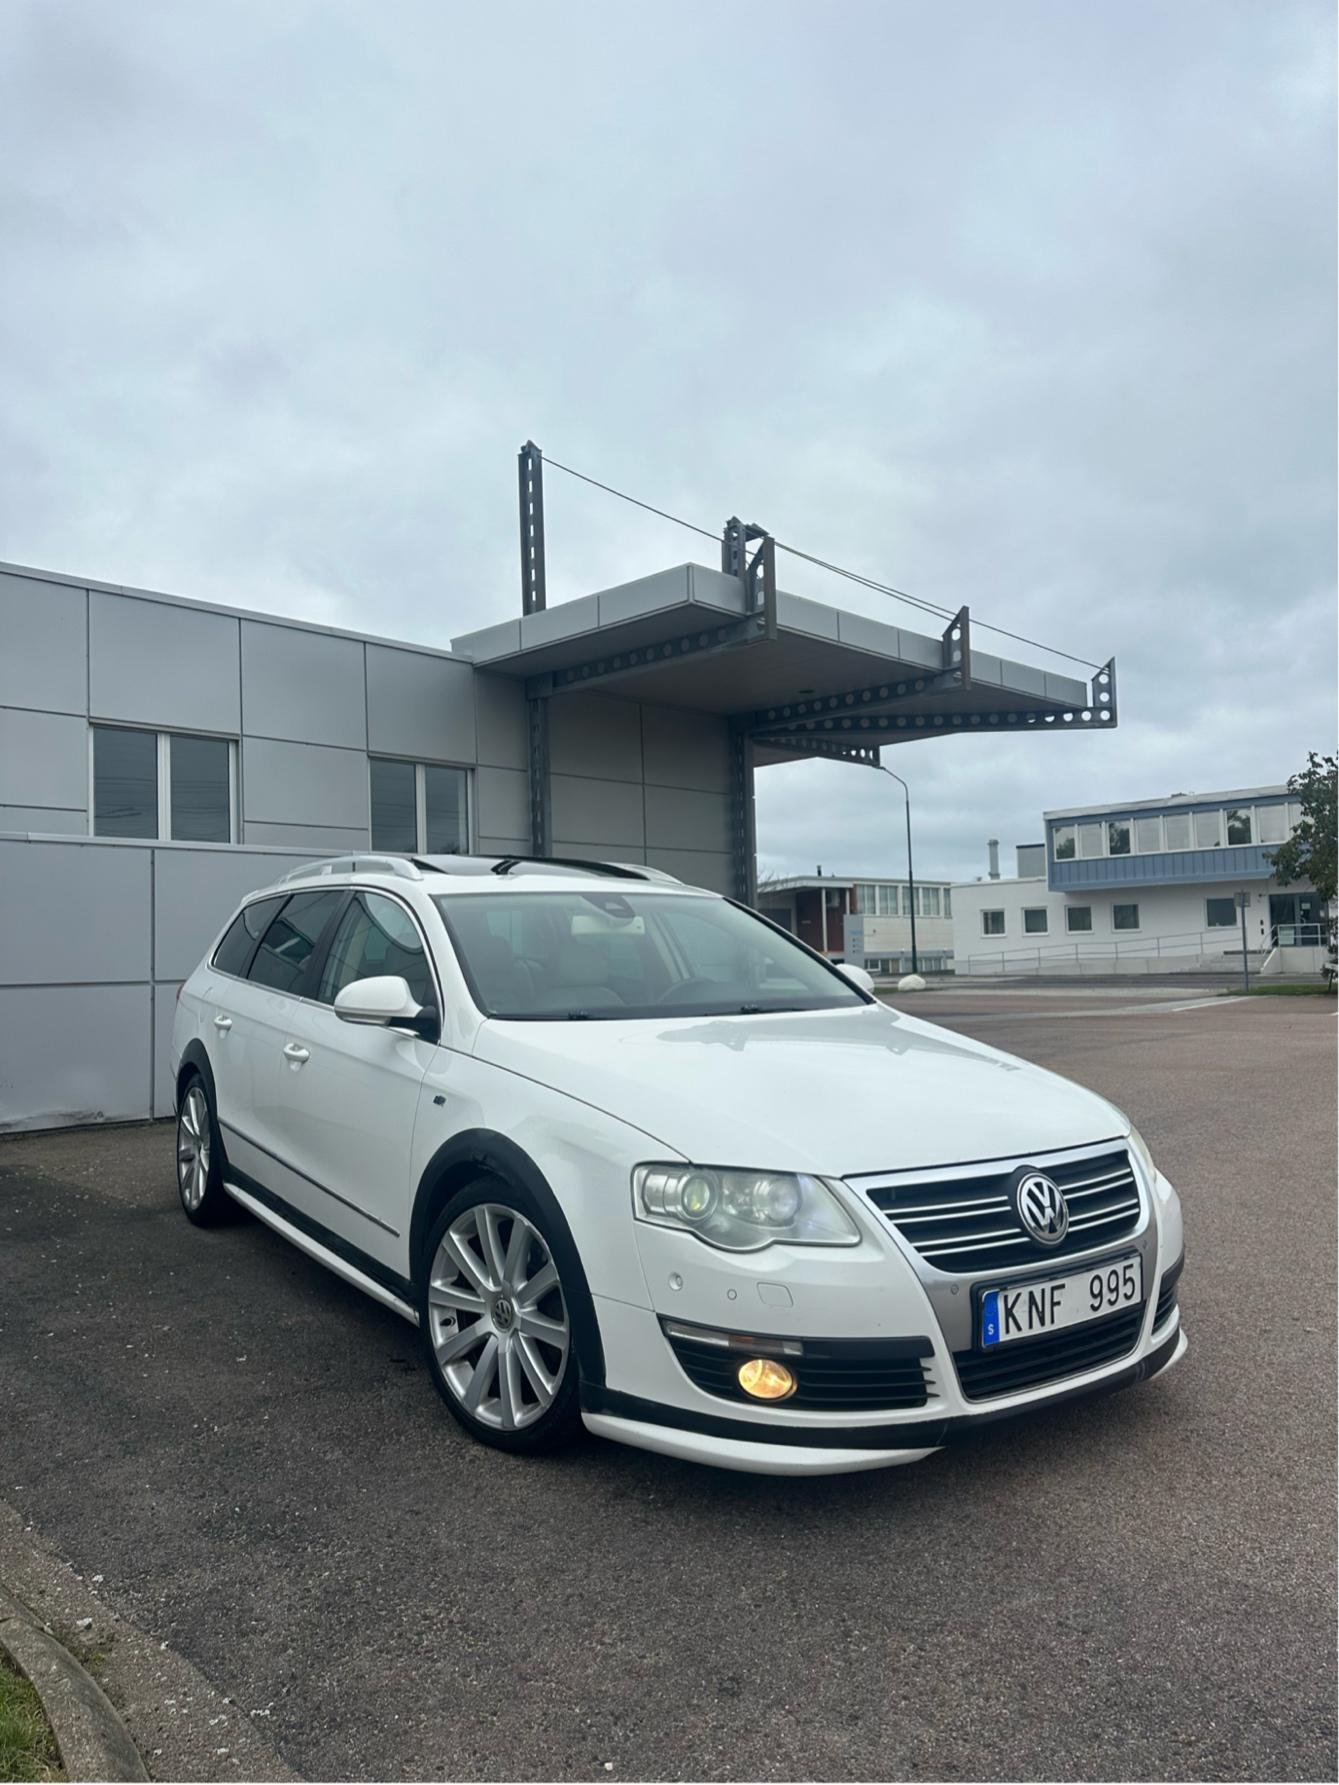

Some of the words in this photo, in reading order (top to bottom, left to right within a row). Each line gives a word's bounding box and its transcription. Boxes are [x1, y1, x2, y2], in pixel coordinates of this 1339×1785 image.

[1019, 1175, 1067, 1242] VW
[987, 1323, 995, 1336] S
[1003, 1282, 1066, 1335] KNF
[1089, 1263, 1136, 1312] 995
